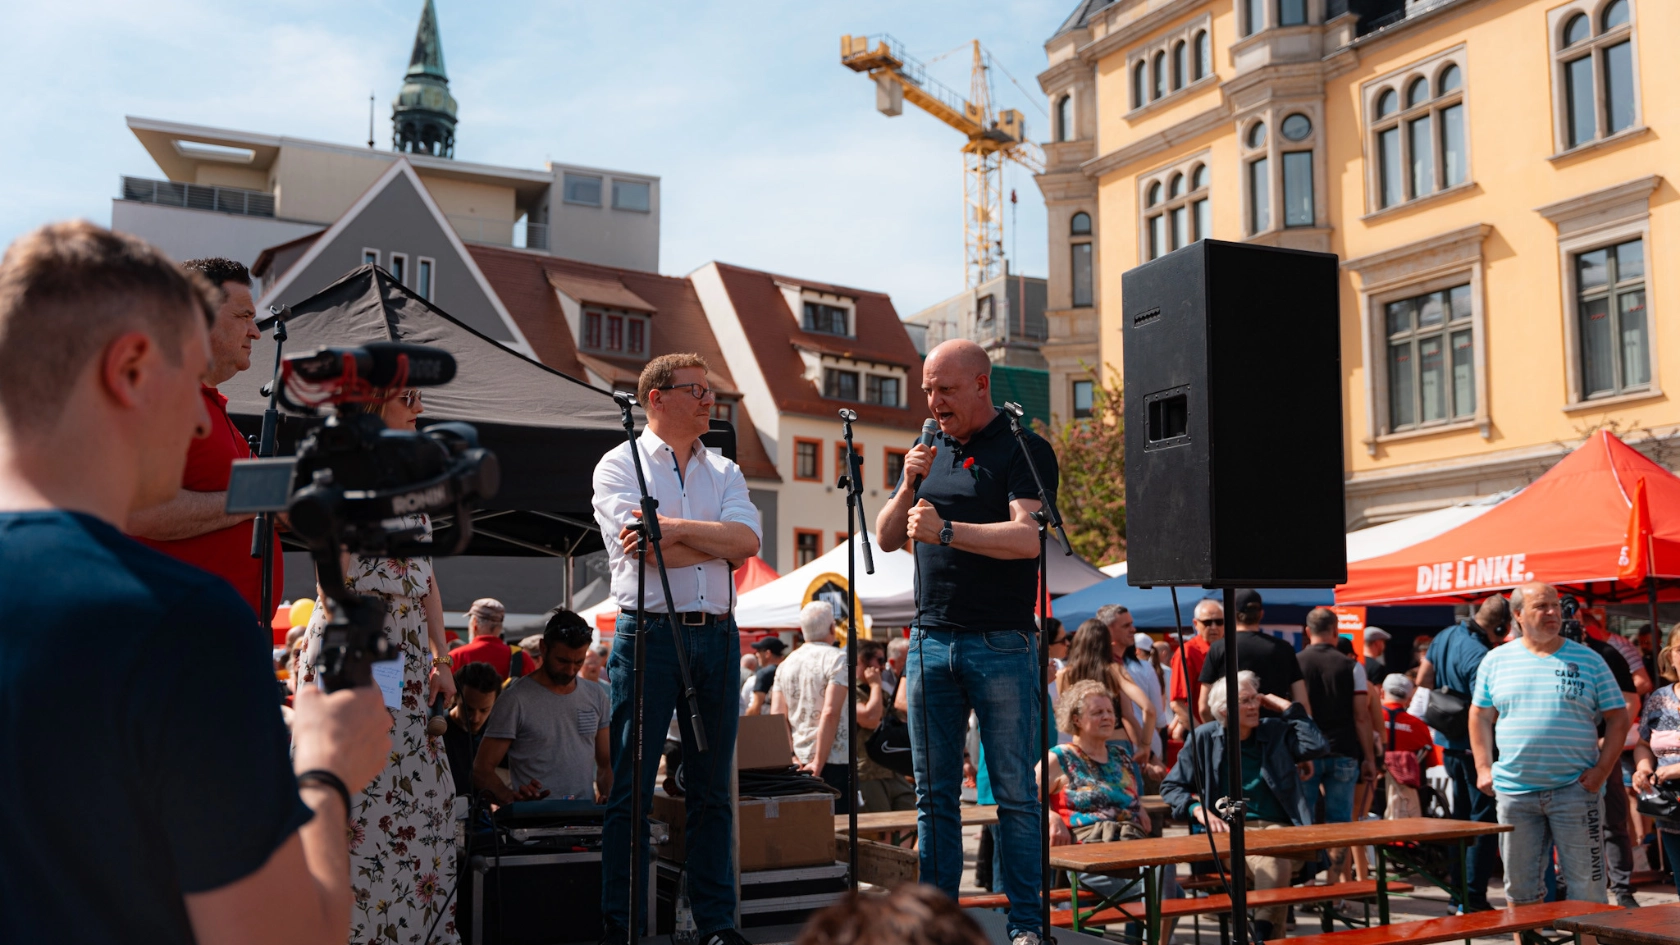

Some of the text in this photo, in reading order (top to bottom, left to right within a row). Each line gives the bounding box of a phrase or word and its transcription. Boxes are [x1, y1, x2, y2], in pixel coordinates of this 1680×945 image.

[1416, 562, 1452, 593] DIE
[1555, 669, 1580, 678] CAMP
[1562, 679, 1585, 689] DAVID
[1587, 809, 1600, 842] CAMP
[1591, 847, 1603, 882] DAVID
